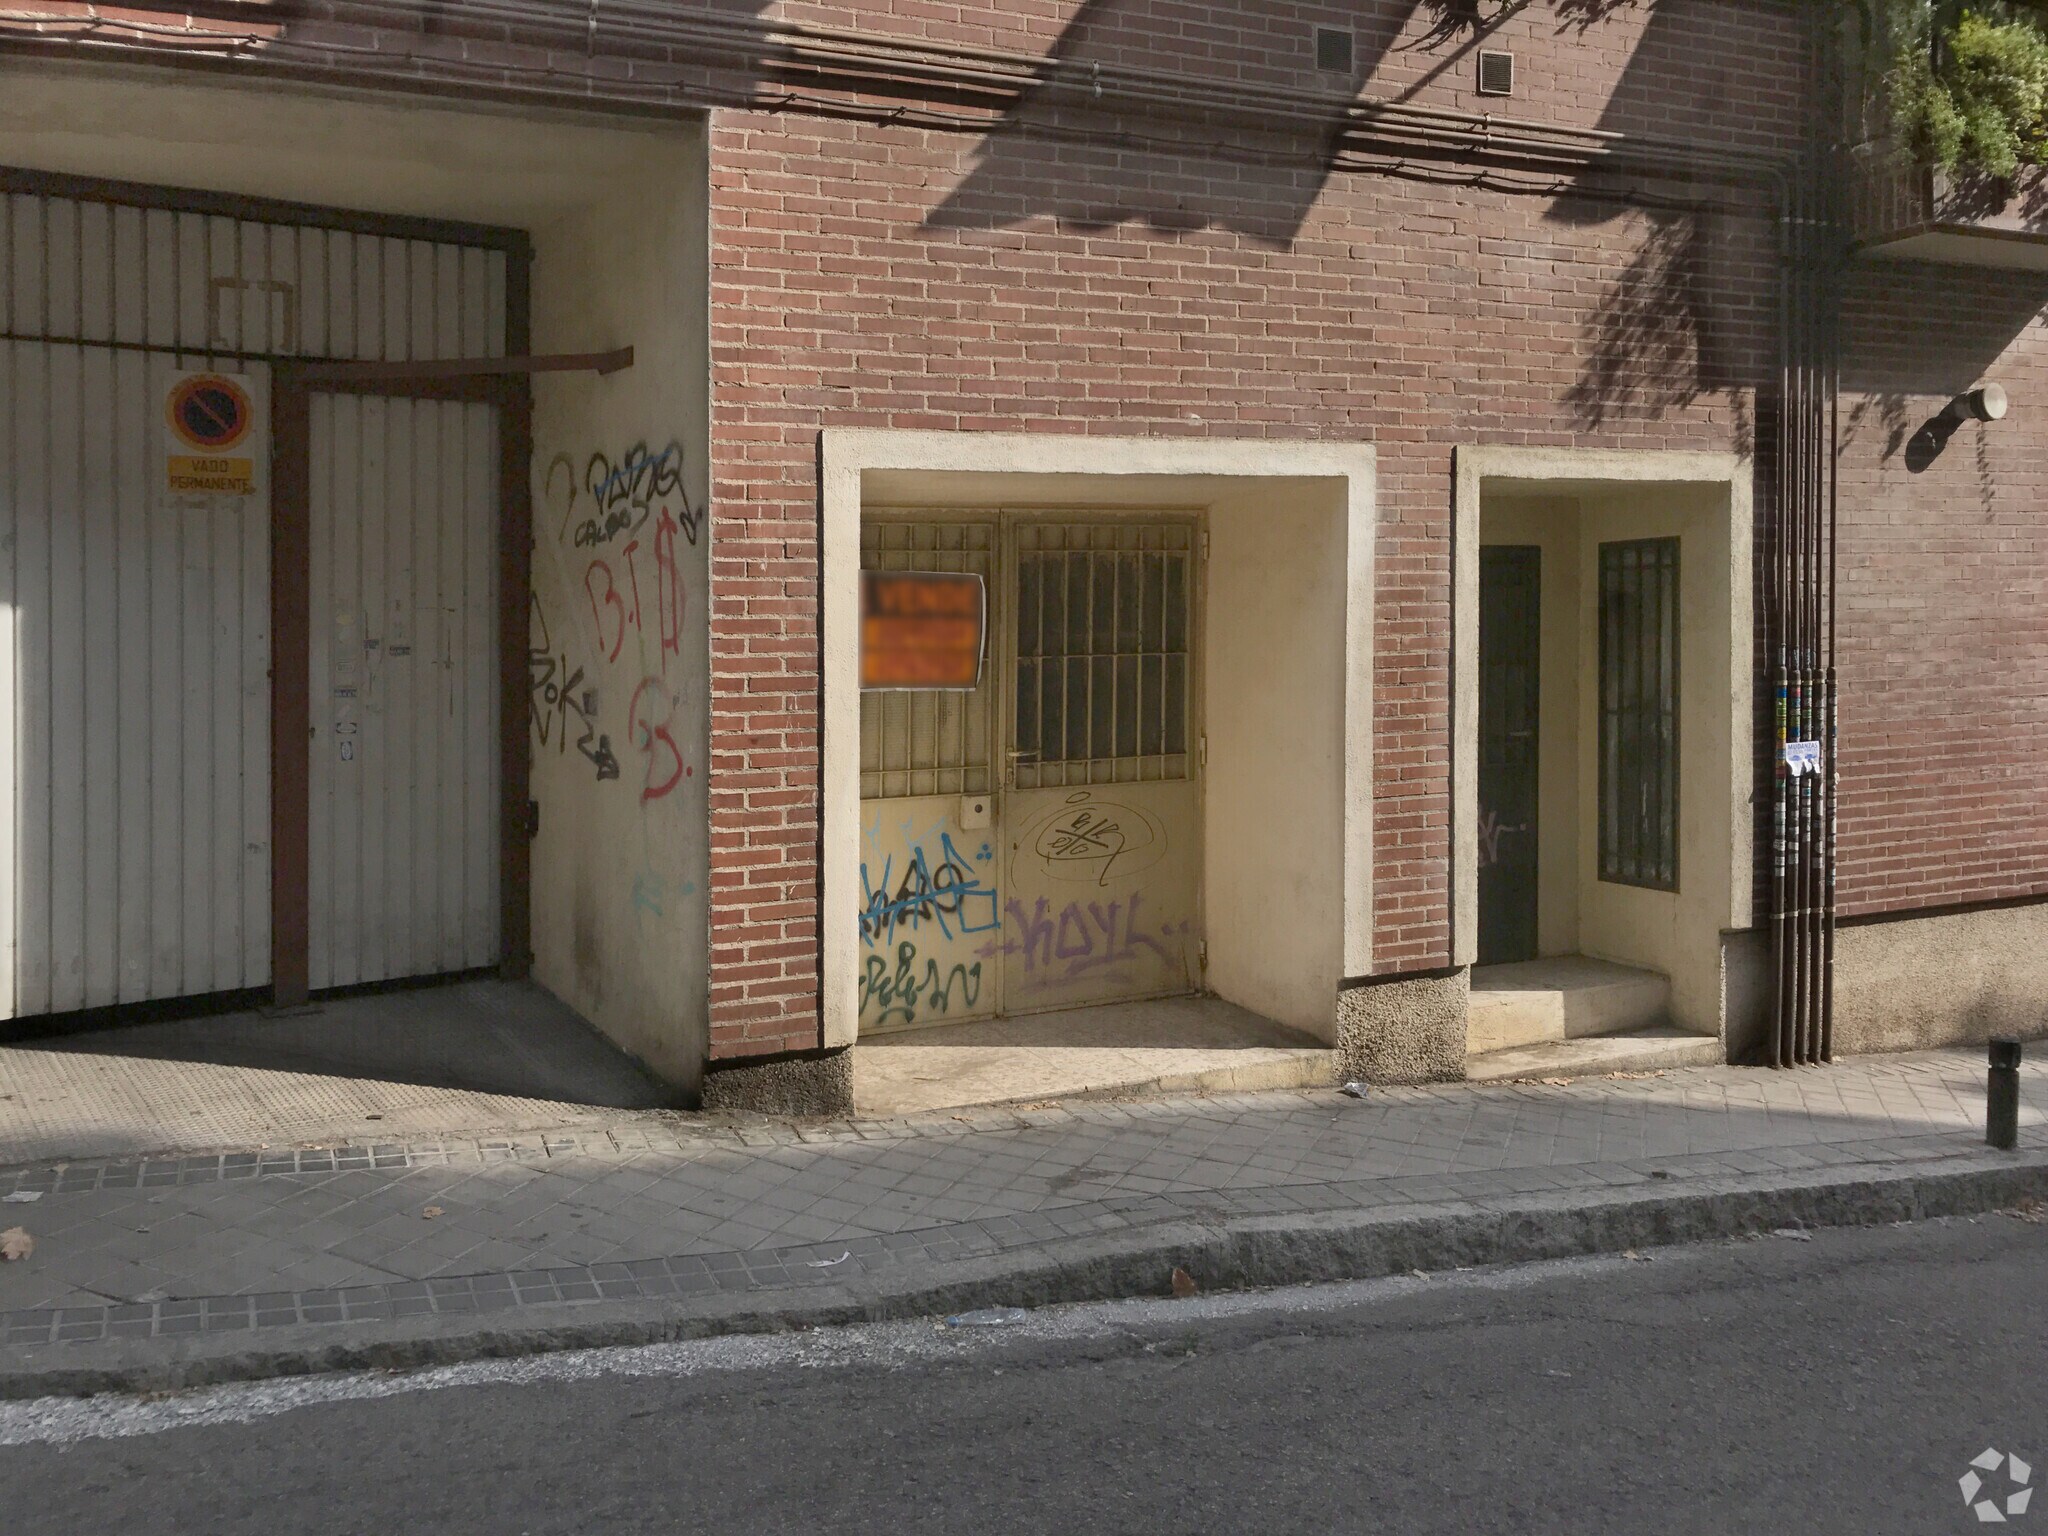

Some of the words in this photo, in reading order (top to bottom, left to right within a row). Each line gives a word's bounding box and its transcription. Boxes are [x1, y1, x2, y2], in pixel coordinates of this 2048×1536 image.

[191, 459, 230, 473] VADO
[170, 475, 250, 490] PERMANENTE
[1787, 742, 1818, 750] MUDANZAS
